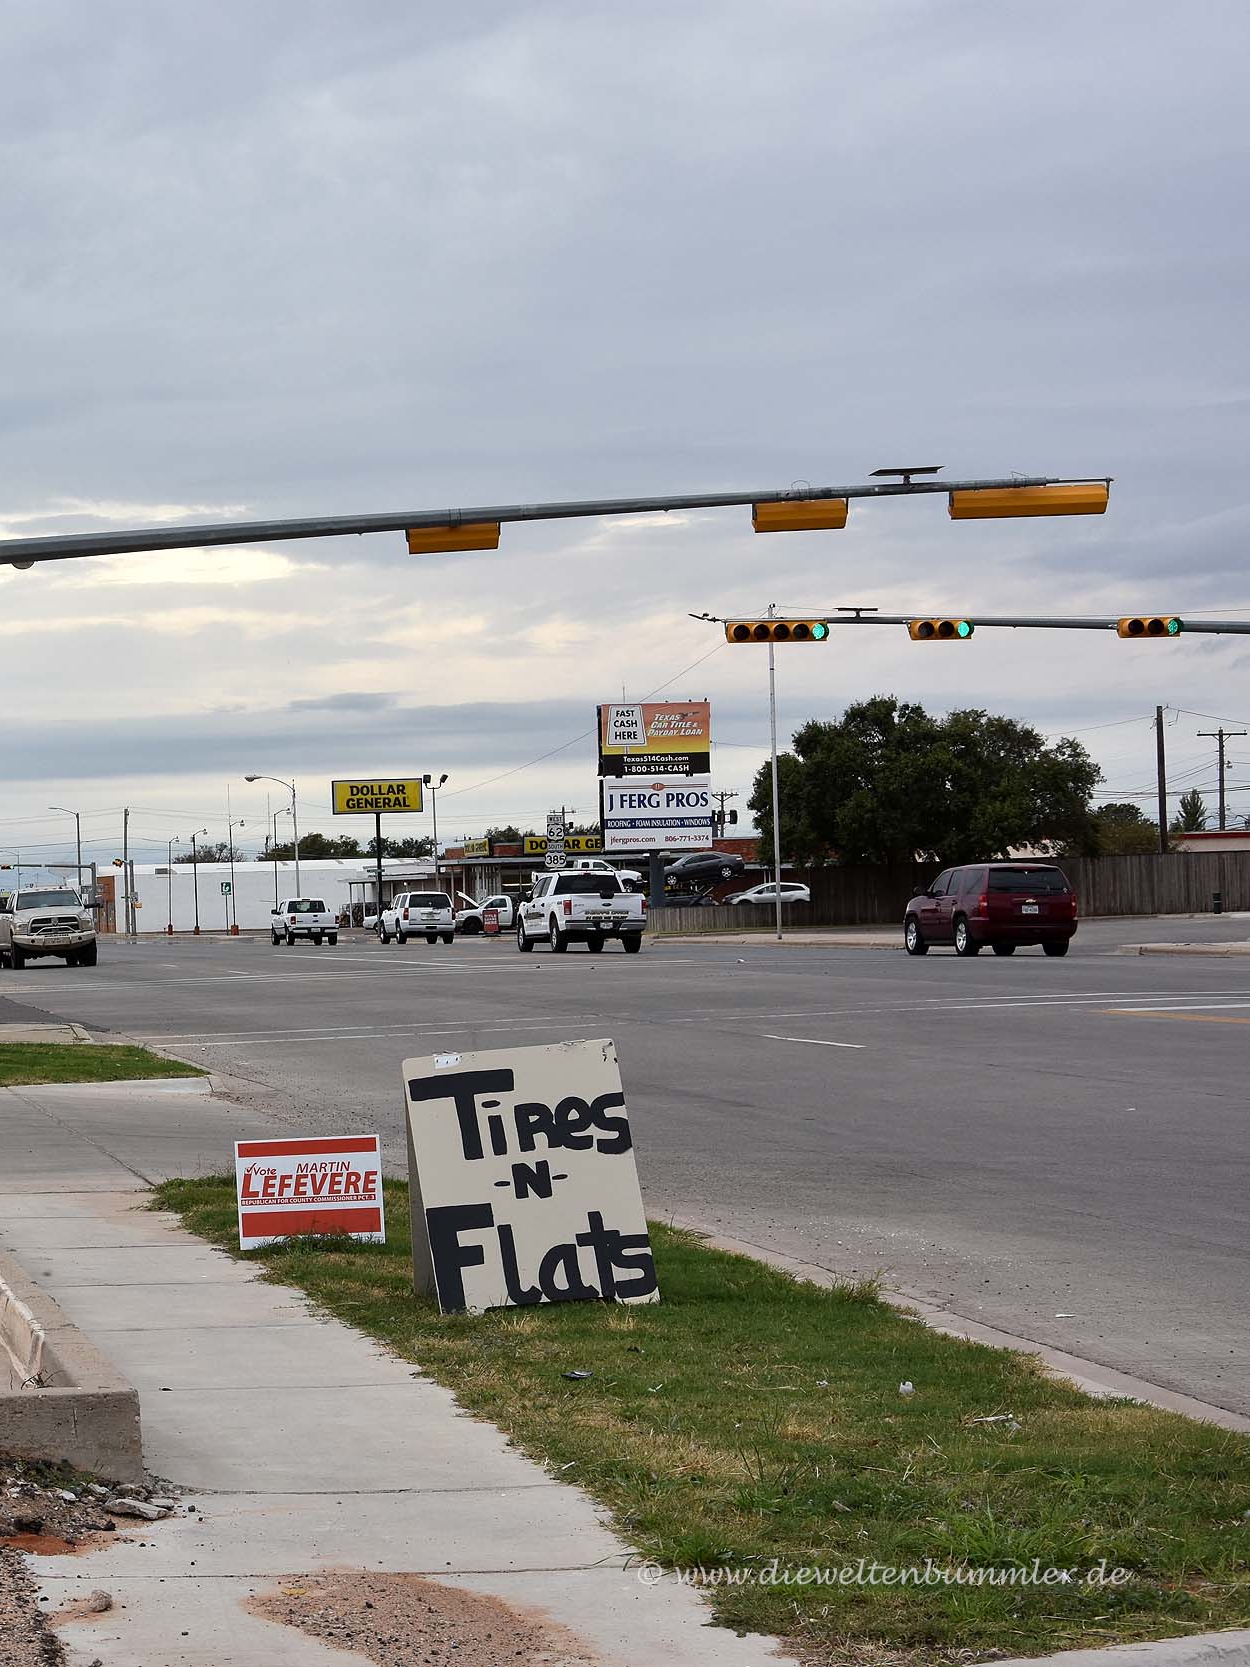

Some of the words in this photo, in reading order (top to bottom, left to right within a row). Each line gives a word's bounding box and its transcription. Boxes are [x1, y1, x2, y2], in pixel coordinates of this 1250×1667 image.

[615, 709, 635, 718] FAST
[613, 719, 638, 728] CASH
[614, 731, 638, 740] HERE
[680, 728, 703, 736] LOAN
[623, 755, 689, 763] Texas514Cash.com
[624, 764, 689, 773] 1-800-514-CASH
[349, 784, 407, 796] DOLLAR
[345, 796, 411, 809] GENERAL
[608, 794, 614, 812] J
[619, 793, 660, 809] FERG
[665, 791, 709, 808] PROS
[607, 820, 631, 828] ROOFING
[635, 819, 650, 827] FOAM
[651, 818, 681, 827] INSULATION
[684, 818, 710, 826] WINDOWS
[548, 827, 563, 837] 62
[529, 838, 581, 850] DOAR
[610, 836, 656, 845] jfergpros.com
[664, 834, 709, 842] 806-771-3374
[545, 855, 566, 865] 385
[253, 1166, 277, 1176] Vote
[296, 1161, 351, 1174] MARTIN
[241, 1170, 378, 1199] LEFEVERE
[241, 1198, 277, 1206] REPUBLICAN
